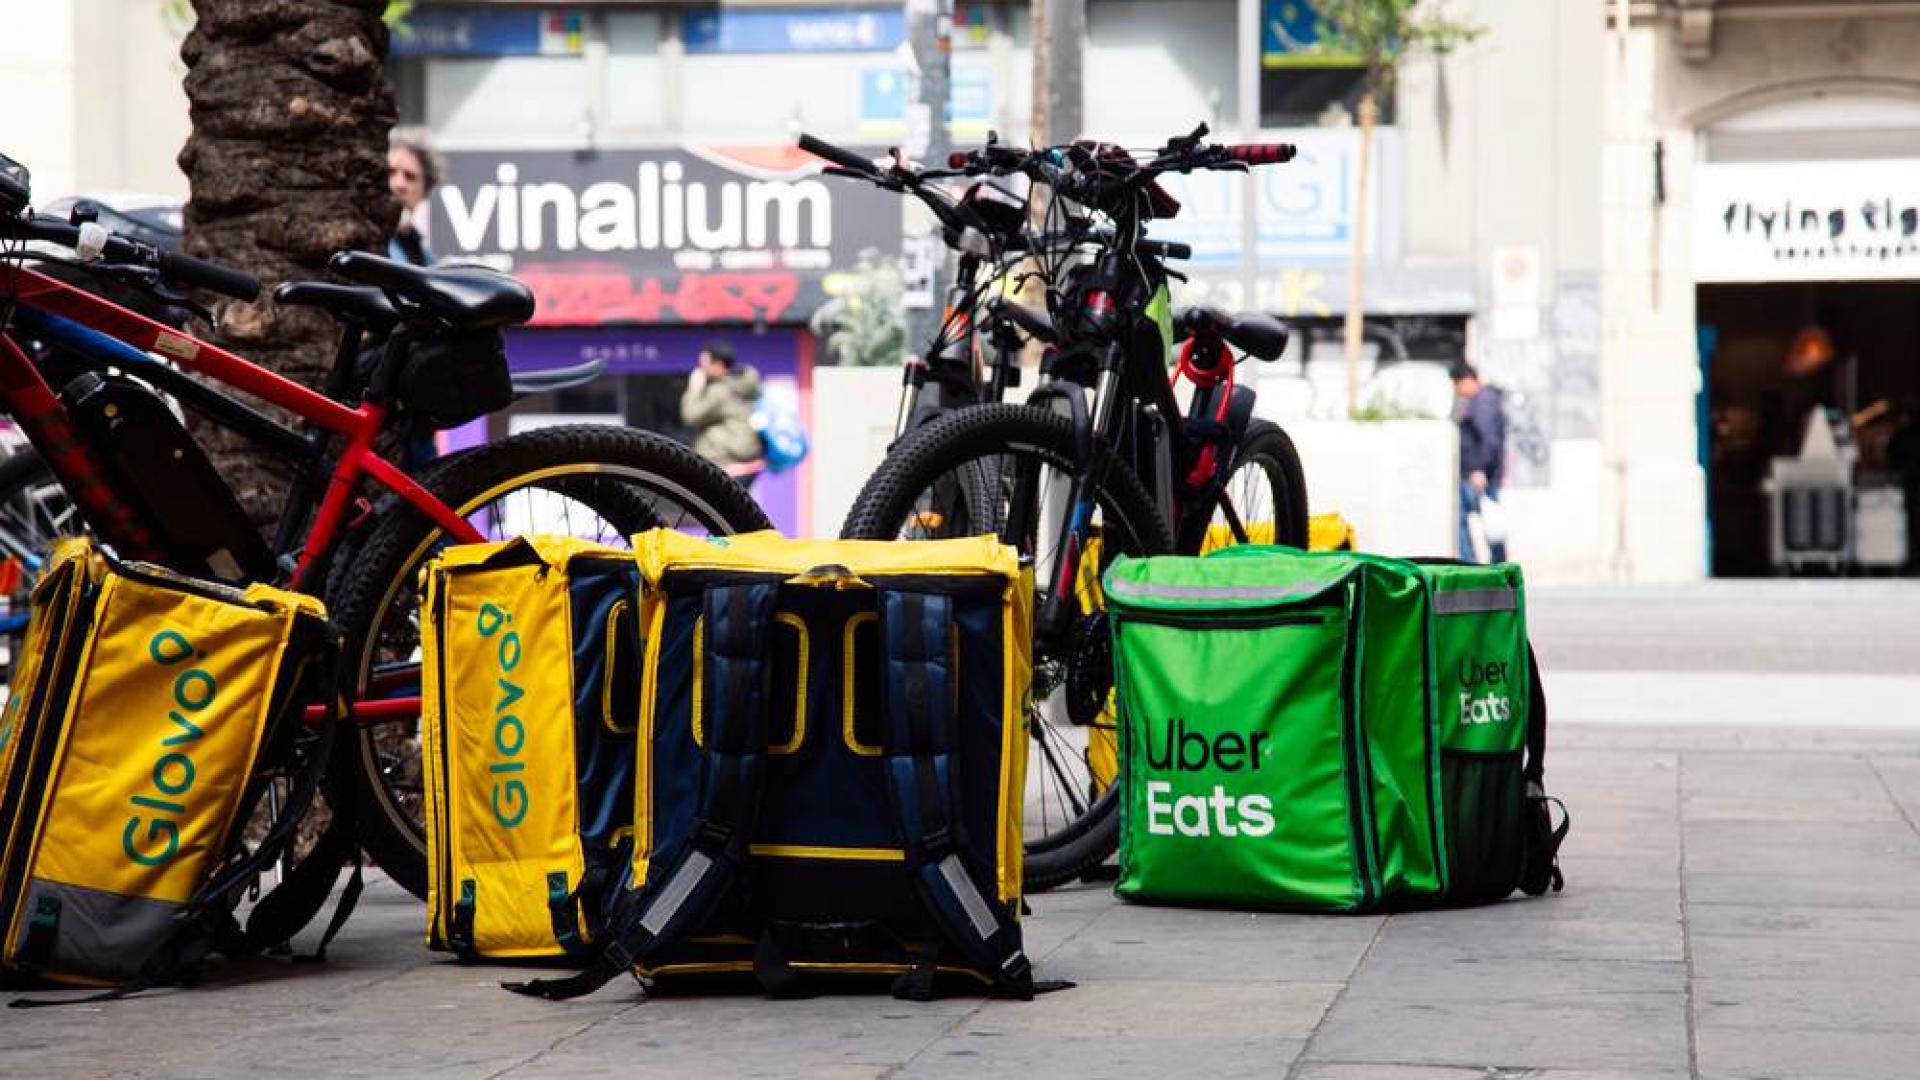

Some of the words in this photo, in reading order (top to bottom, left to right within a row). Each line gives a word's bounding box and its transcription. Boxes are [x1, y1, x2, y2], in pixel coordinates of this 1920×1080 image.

[439, 161, 832, 251] vinalium
[1723, 200, 1845, 241] flying
[1458, 655, 1507, 686] Uber
[482, 630, 529, 829] Glovo
[1459, 692, 1511, 724] Eats
[122, 667, 217, 867] Glovo
[1143, 715, 1269, 772] Uber
[1147, 780, 1276, 837] Eats
